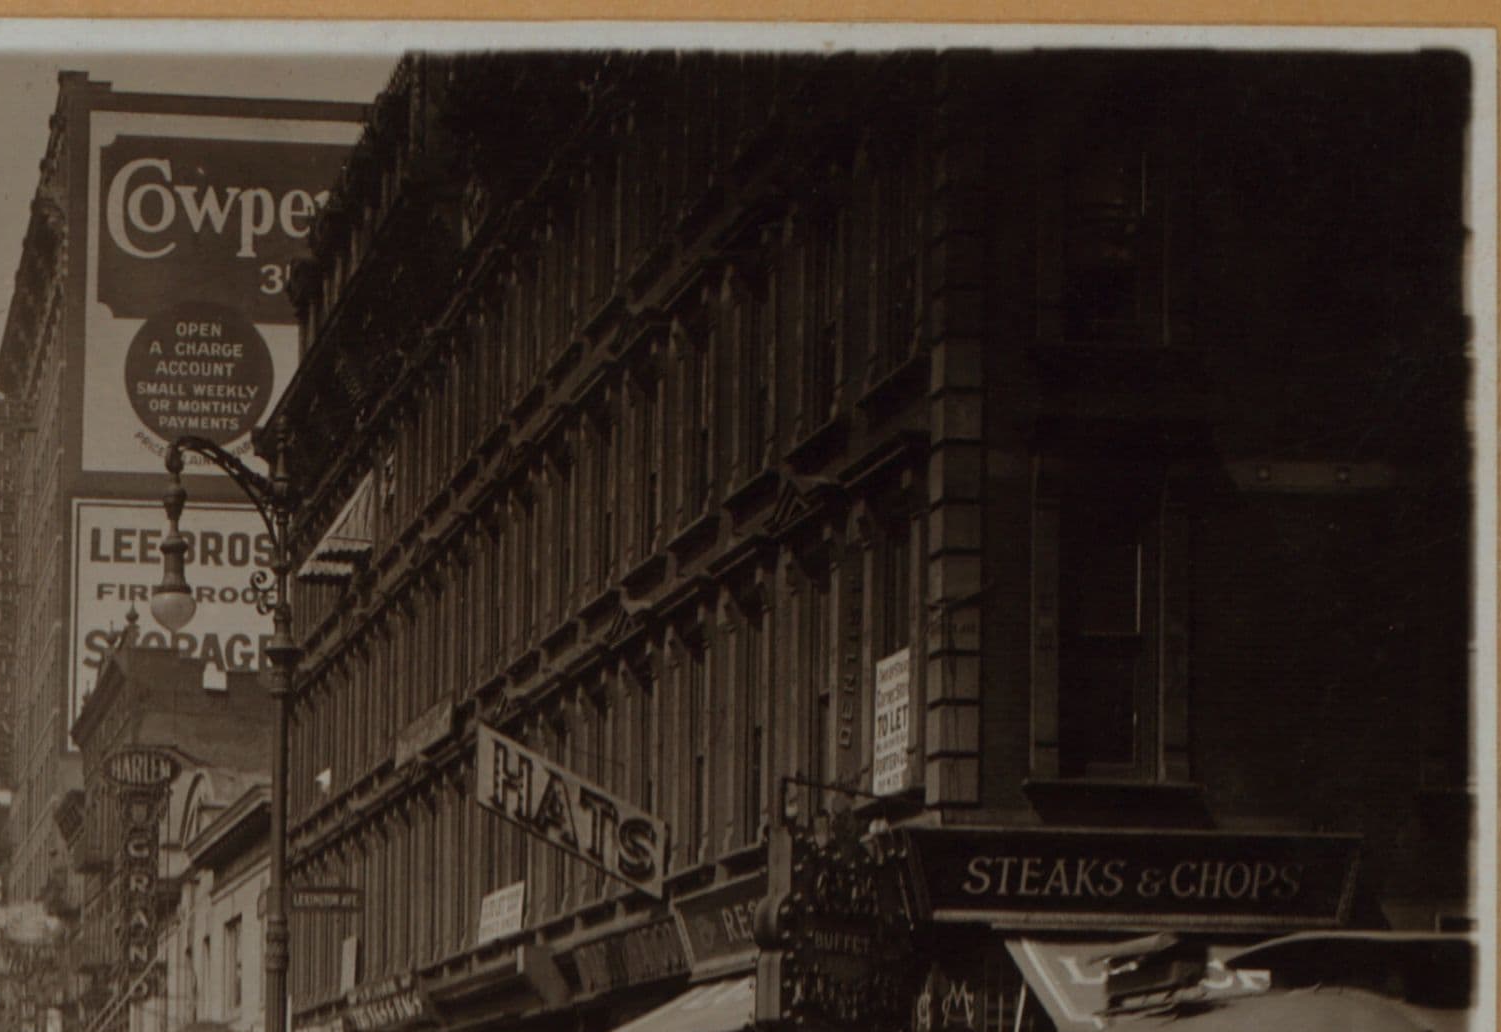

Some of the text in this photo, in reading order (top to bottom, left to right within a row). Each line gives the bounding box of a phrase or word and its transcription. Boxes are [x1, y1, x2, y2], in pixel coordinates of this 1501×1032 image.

[107, 158, 329, 259] Cowpe
[260, 264, 292, 295] 3
[176, 321, 222, 337] OPEN
[149, 341, 243, 358] A CHARGE
[156, 360, 235, 378] ACCOUNT
[136, 381, 258, 399] SMALL WEEKLY
[149, 399, 251, 415] OR MONTHLY
[158, 415, 240, 431] PAYMENTS
[90, 527, 162, 563] LEE
[890, 702, 909, 732] LET
[111, 752, 171, 784] HARLEM
[491, 738, 657, 883] HATS
[960, 855, 1304, 899] STEAKS & CHOPS
[127, 838, 152, 1003] GRAND
